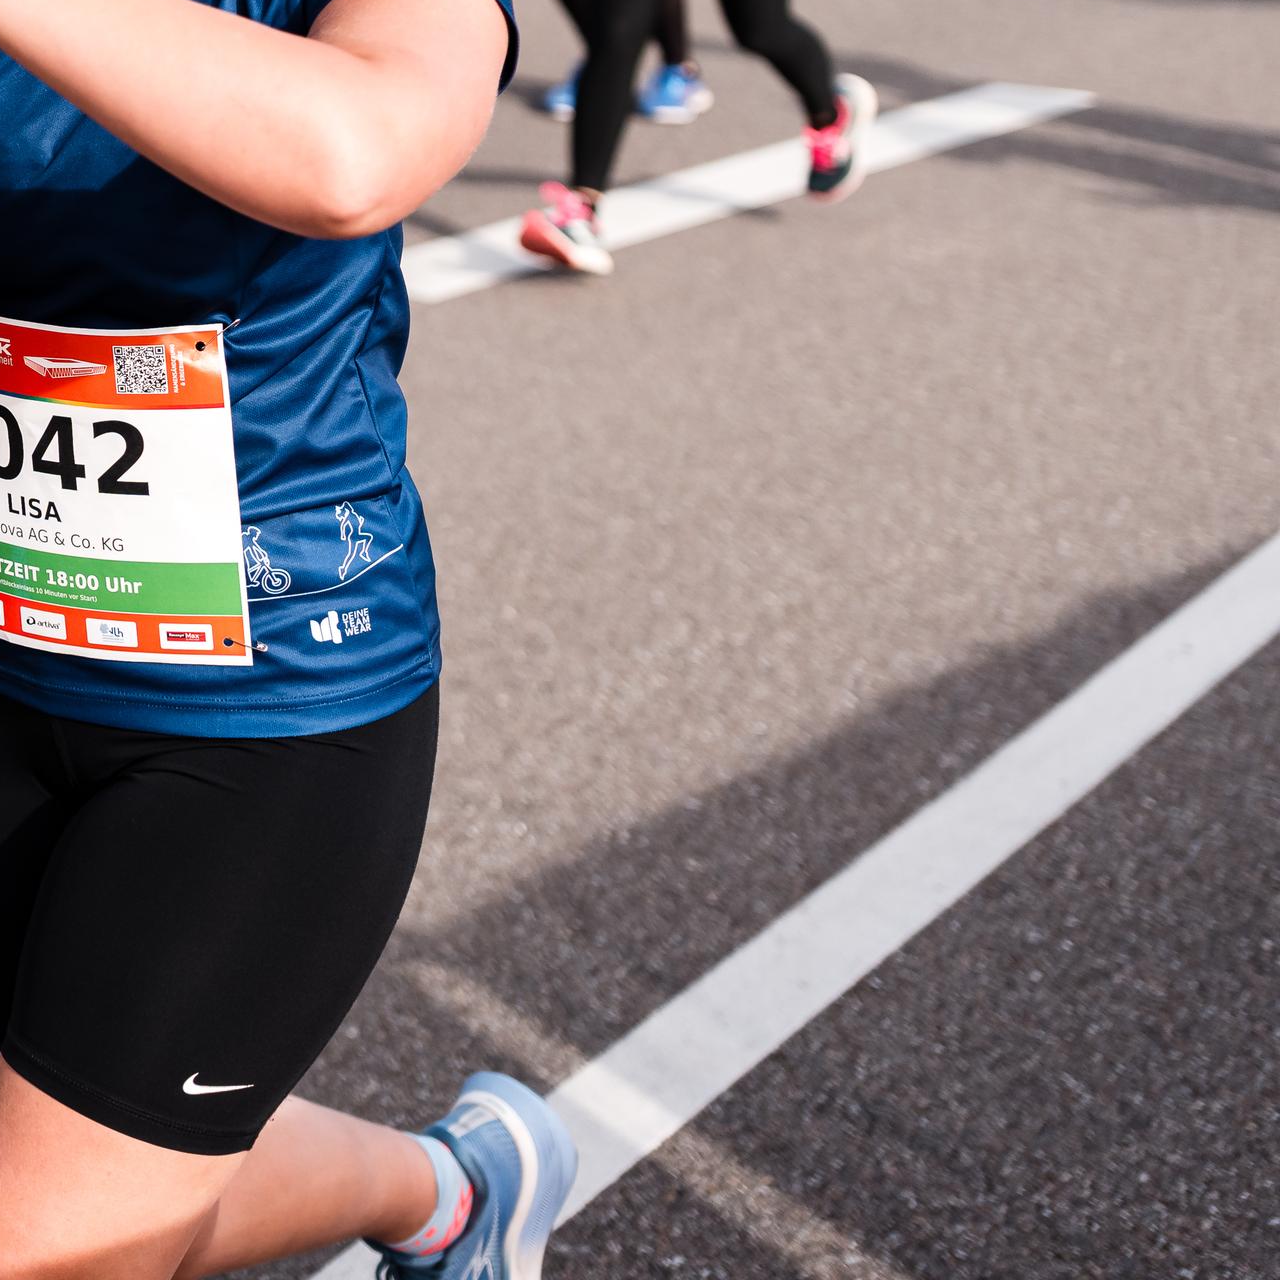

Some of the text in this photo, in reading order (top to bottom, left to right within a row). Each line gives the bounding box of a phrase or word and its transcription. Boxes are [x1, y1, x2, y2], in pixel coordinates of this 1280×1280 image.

[7, 493, 62, 522] LISA
[28, 527, 49, 543] AG
[54, 531, 65, 546] &
[71, 534, 96, 549] Co.
[102, 537, 124, 552] KG
[45, 569, 99, 591] 18:00
[105, 577, 143, 594] Uhr
[35, 587, 43, 595] 10
[44, 588, 68, 598] Minuten
[80, 594, 98, 603] Start)
[342, 607, 369, 622] DEINE
[343, 615, 370, 629] TEAM
[344, 623, 372, 637] WEAR
